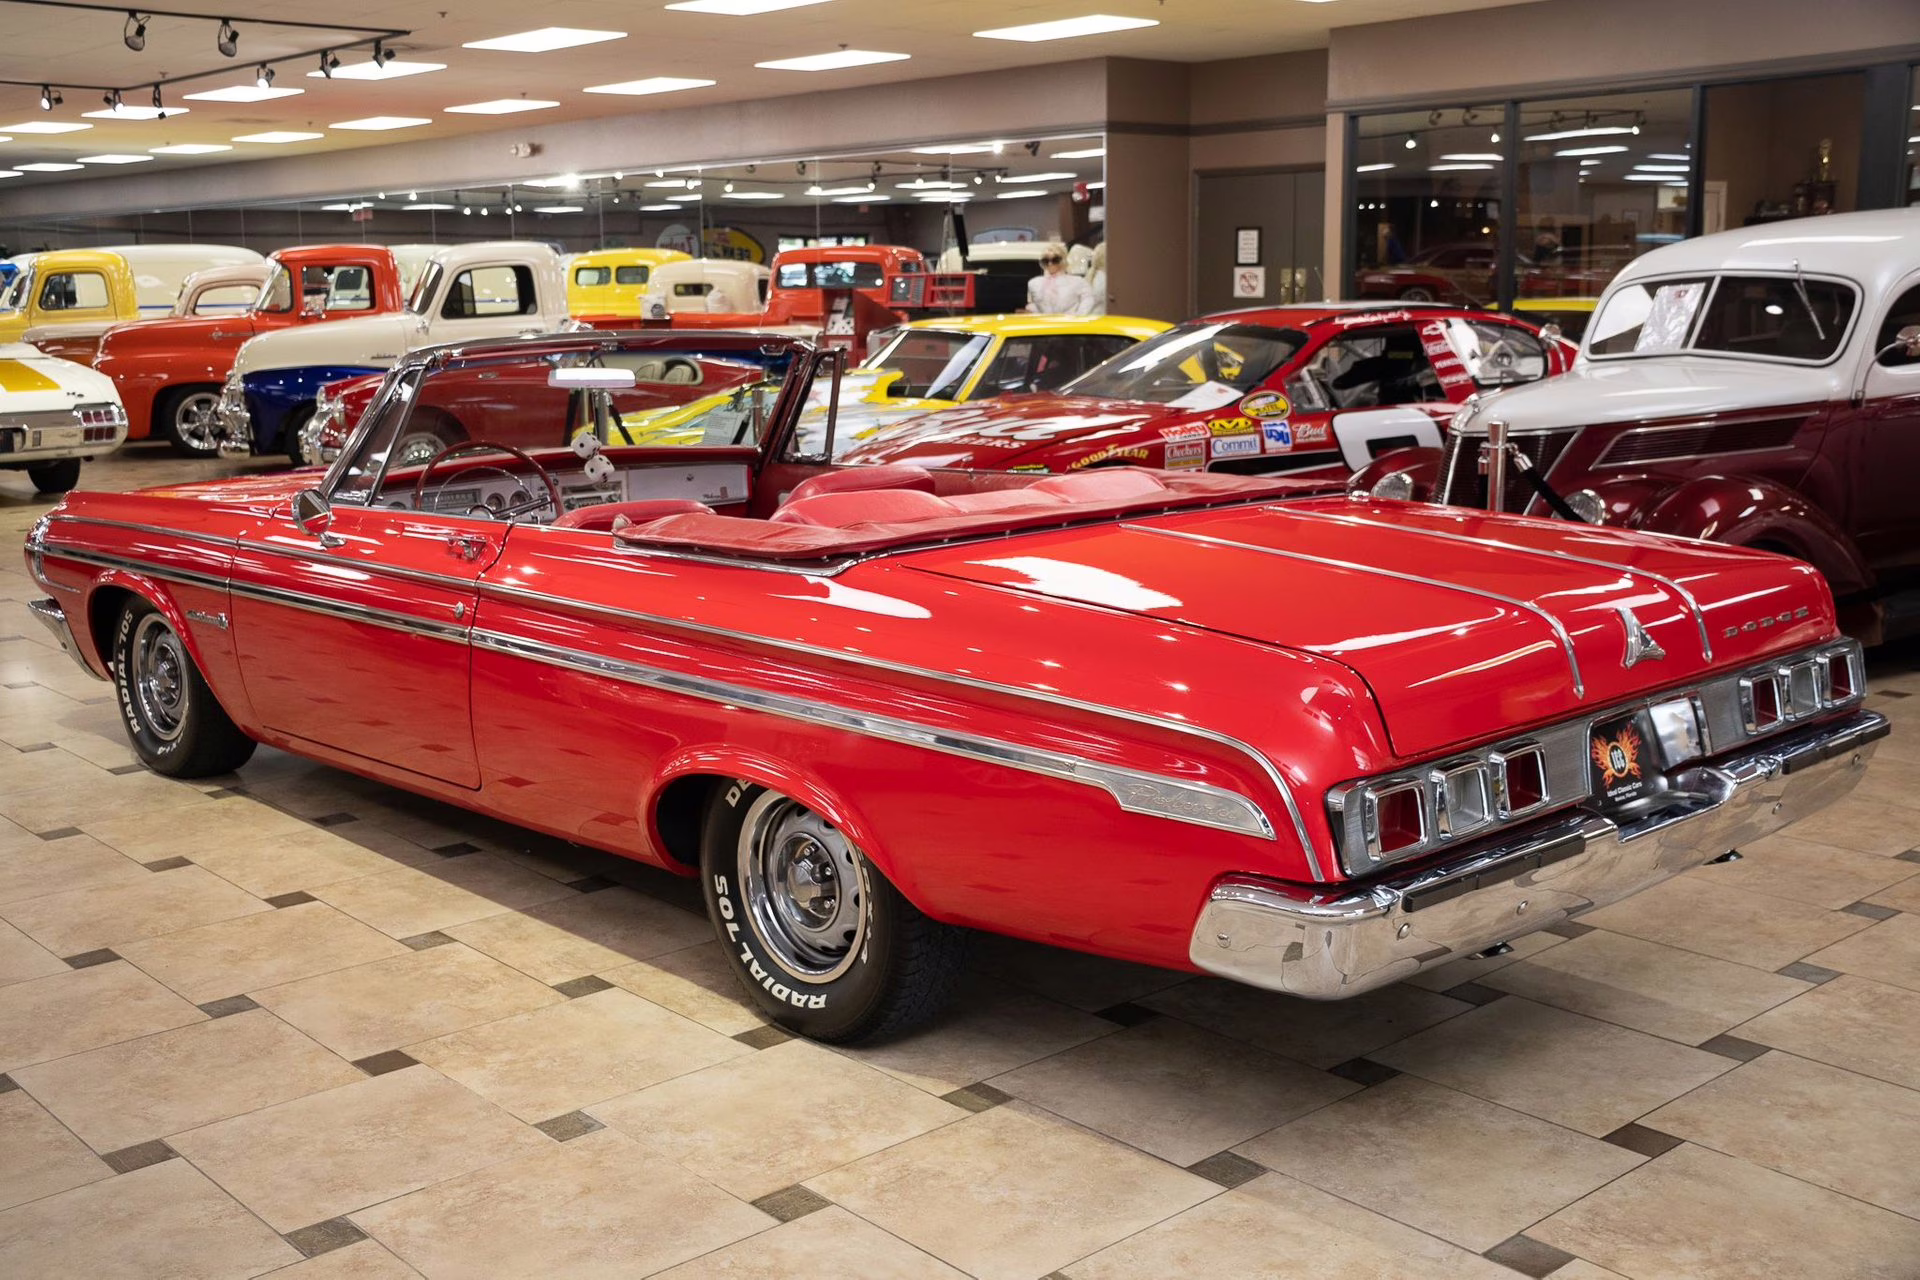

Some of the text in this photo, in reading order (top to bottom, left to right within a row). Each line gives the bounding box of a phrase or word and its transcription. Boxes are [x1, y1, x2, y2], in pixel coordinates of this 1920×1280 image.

[1212, 437, 1258, 454] Commit
[1721, 606, 1809, 638] DODGE
[118, 650, 141, 734] RADIAL
[740, 942, 828, 1009] RADIAL
